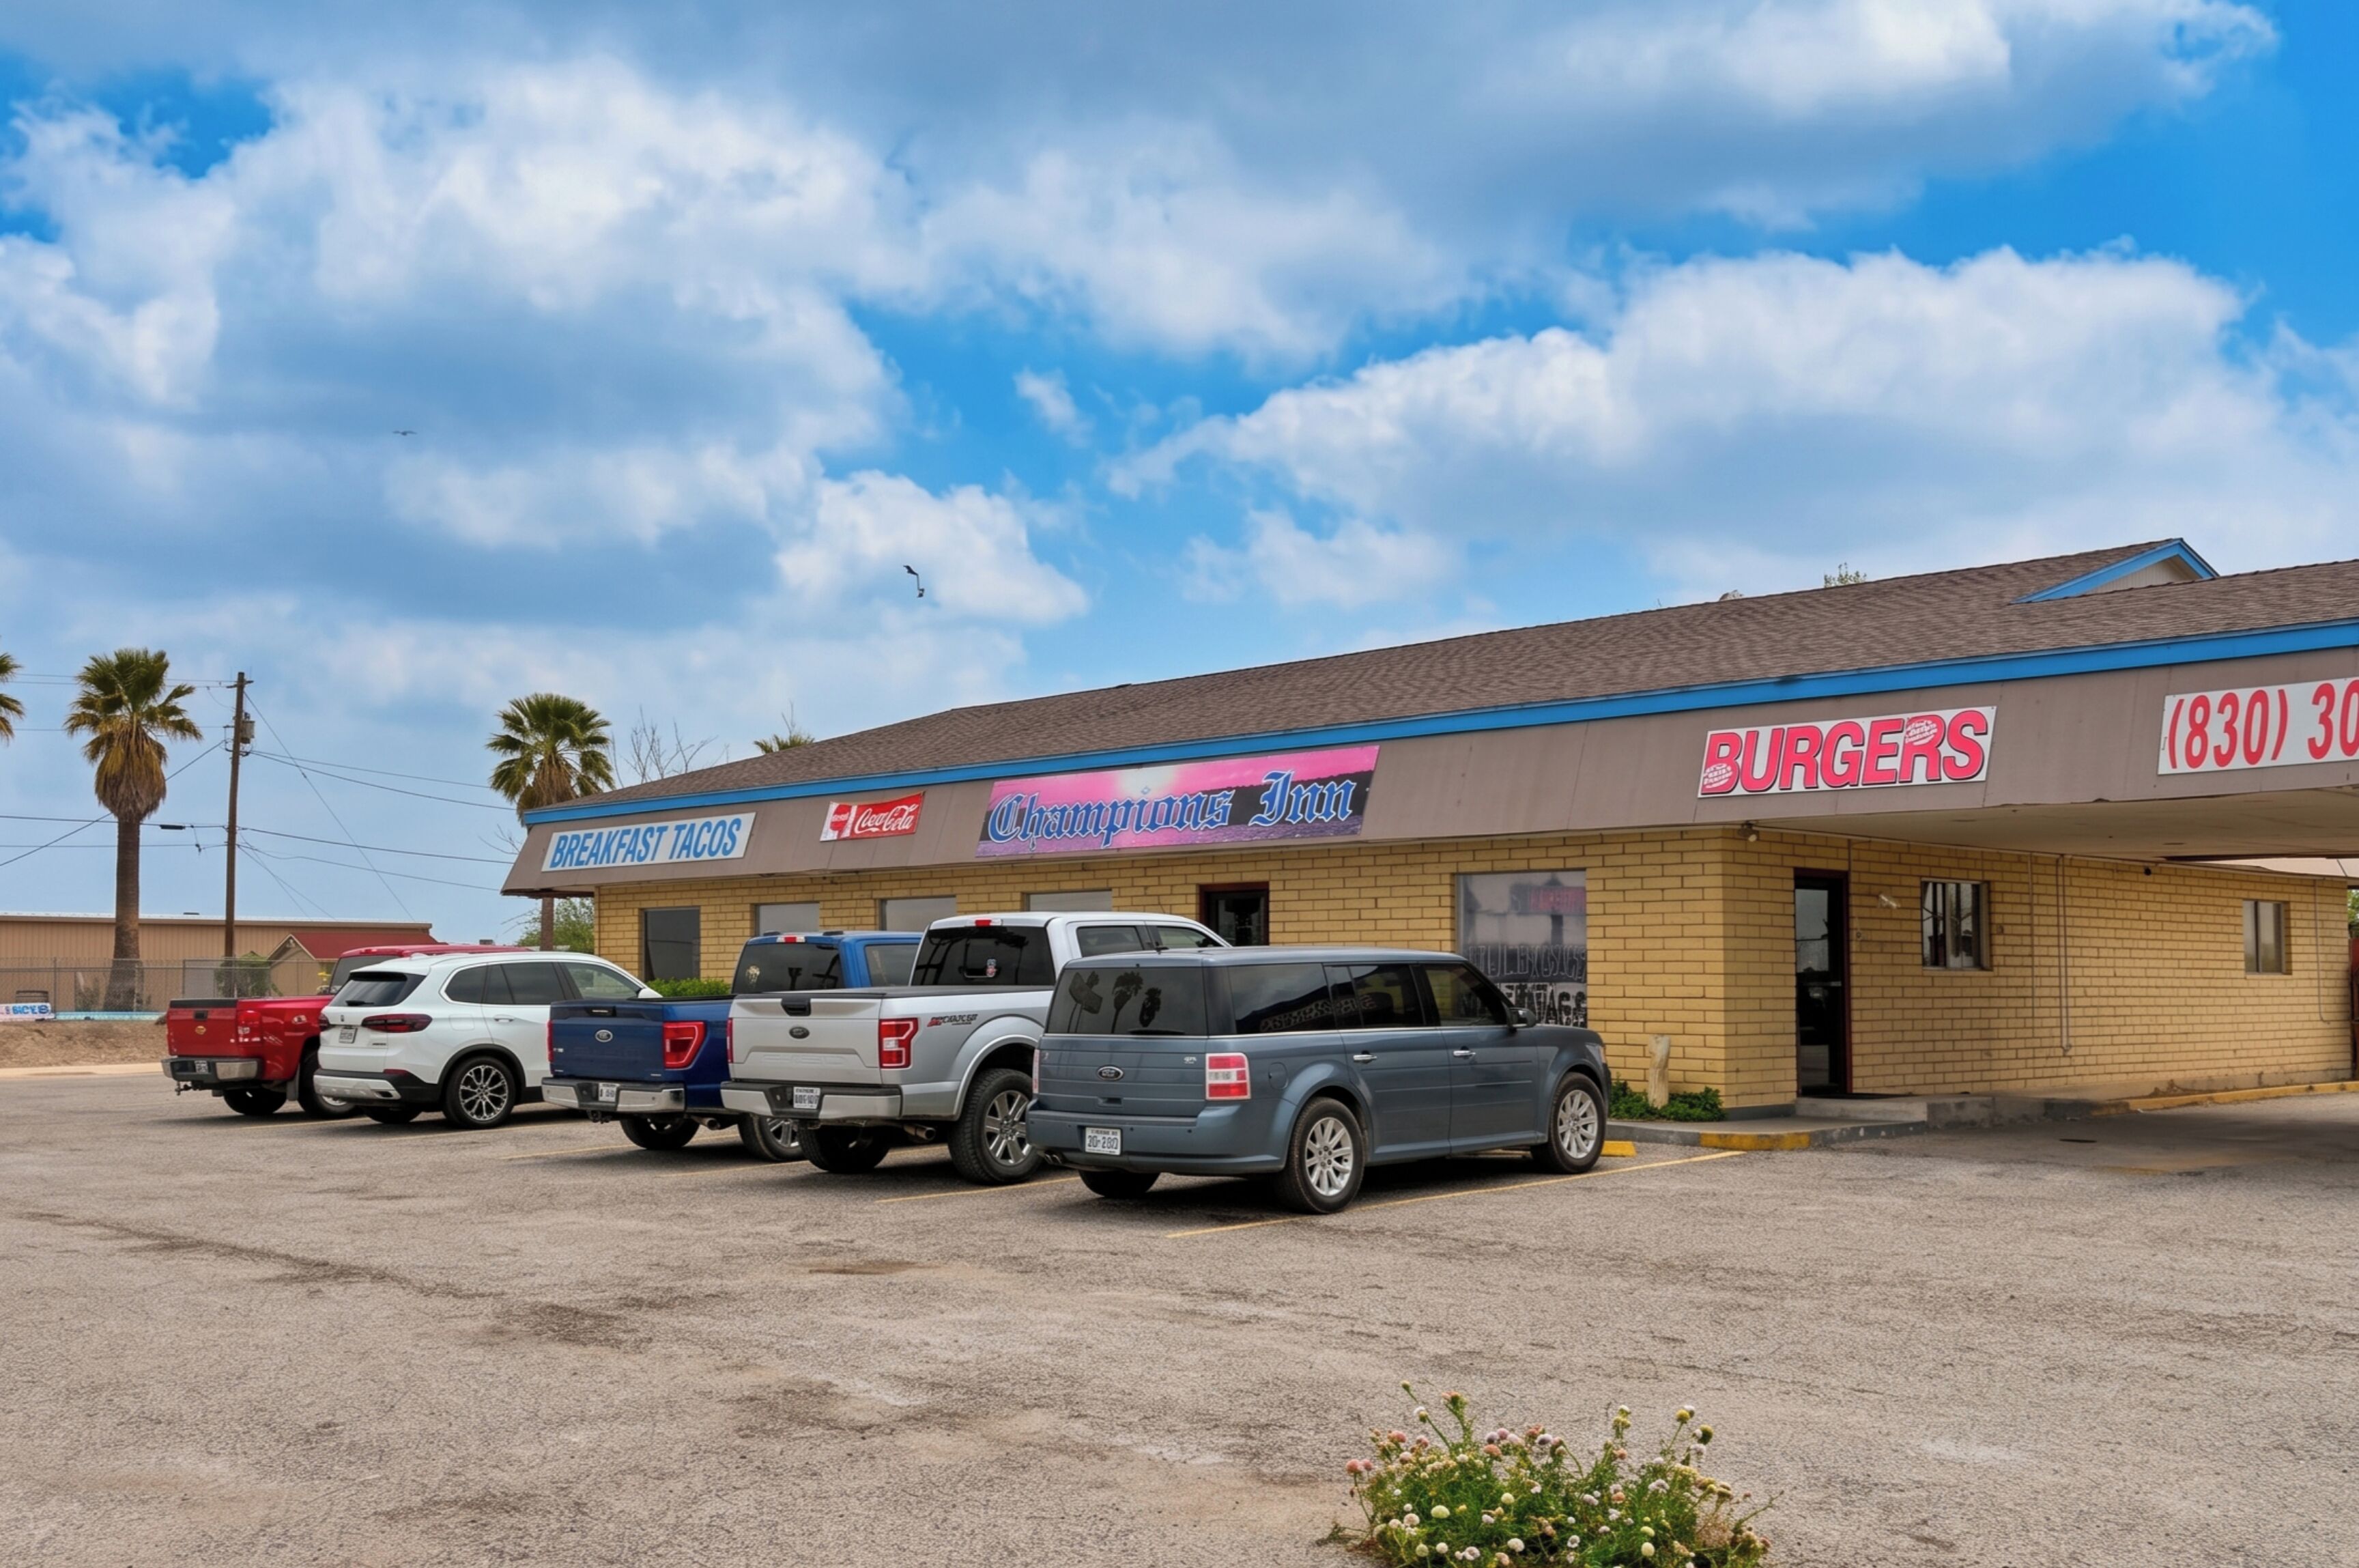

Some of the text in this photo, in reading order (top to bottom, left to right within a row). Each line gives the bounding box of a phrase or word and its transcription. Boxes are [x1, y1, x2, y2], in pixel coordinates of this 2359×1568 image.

[1700, 710, 1988, 795] BURGERS
[2168, 679, 2359, 769] (830) 30
[549, 818, 742, 868] BREAKFAST TACOS
[988, 769, 1357, 849] Champions Inn
